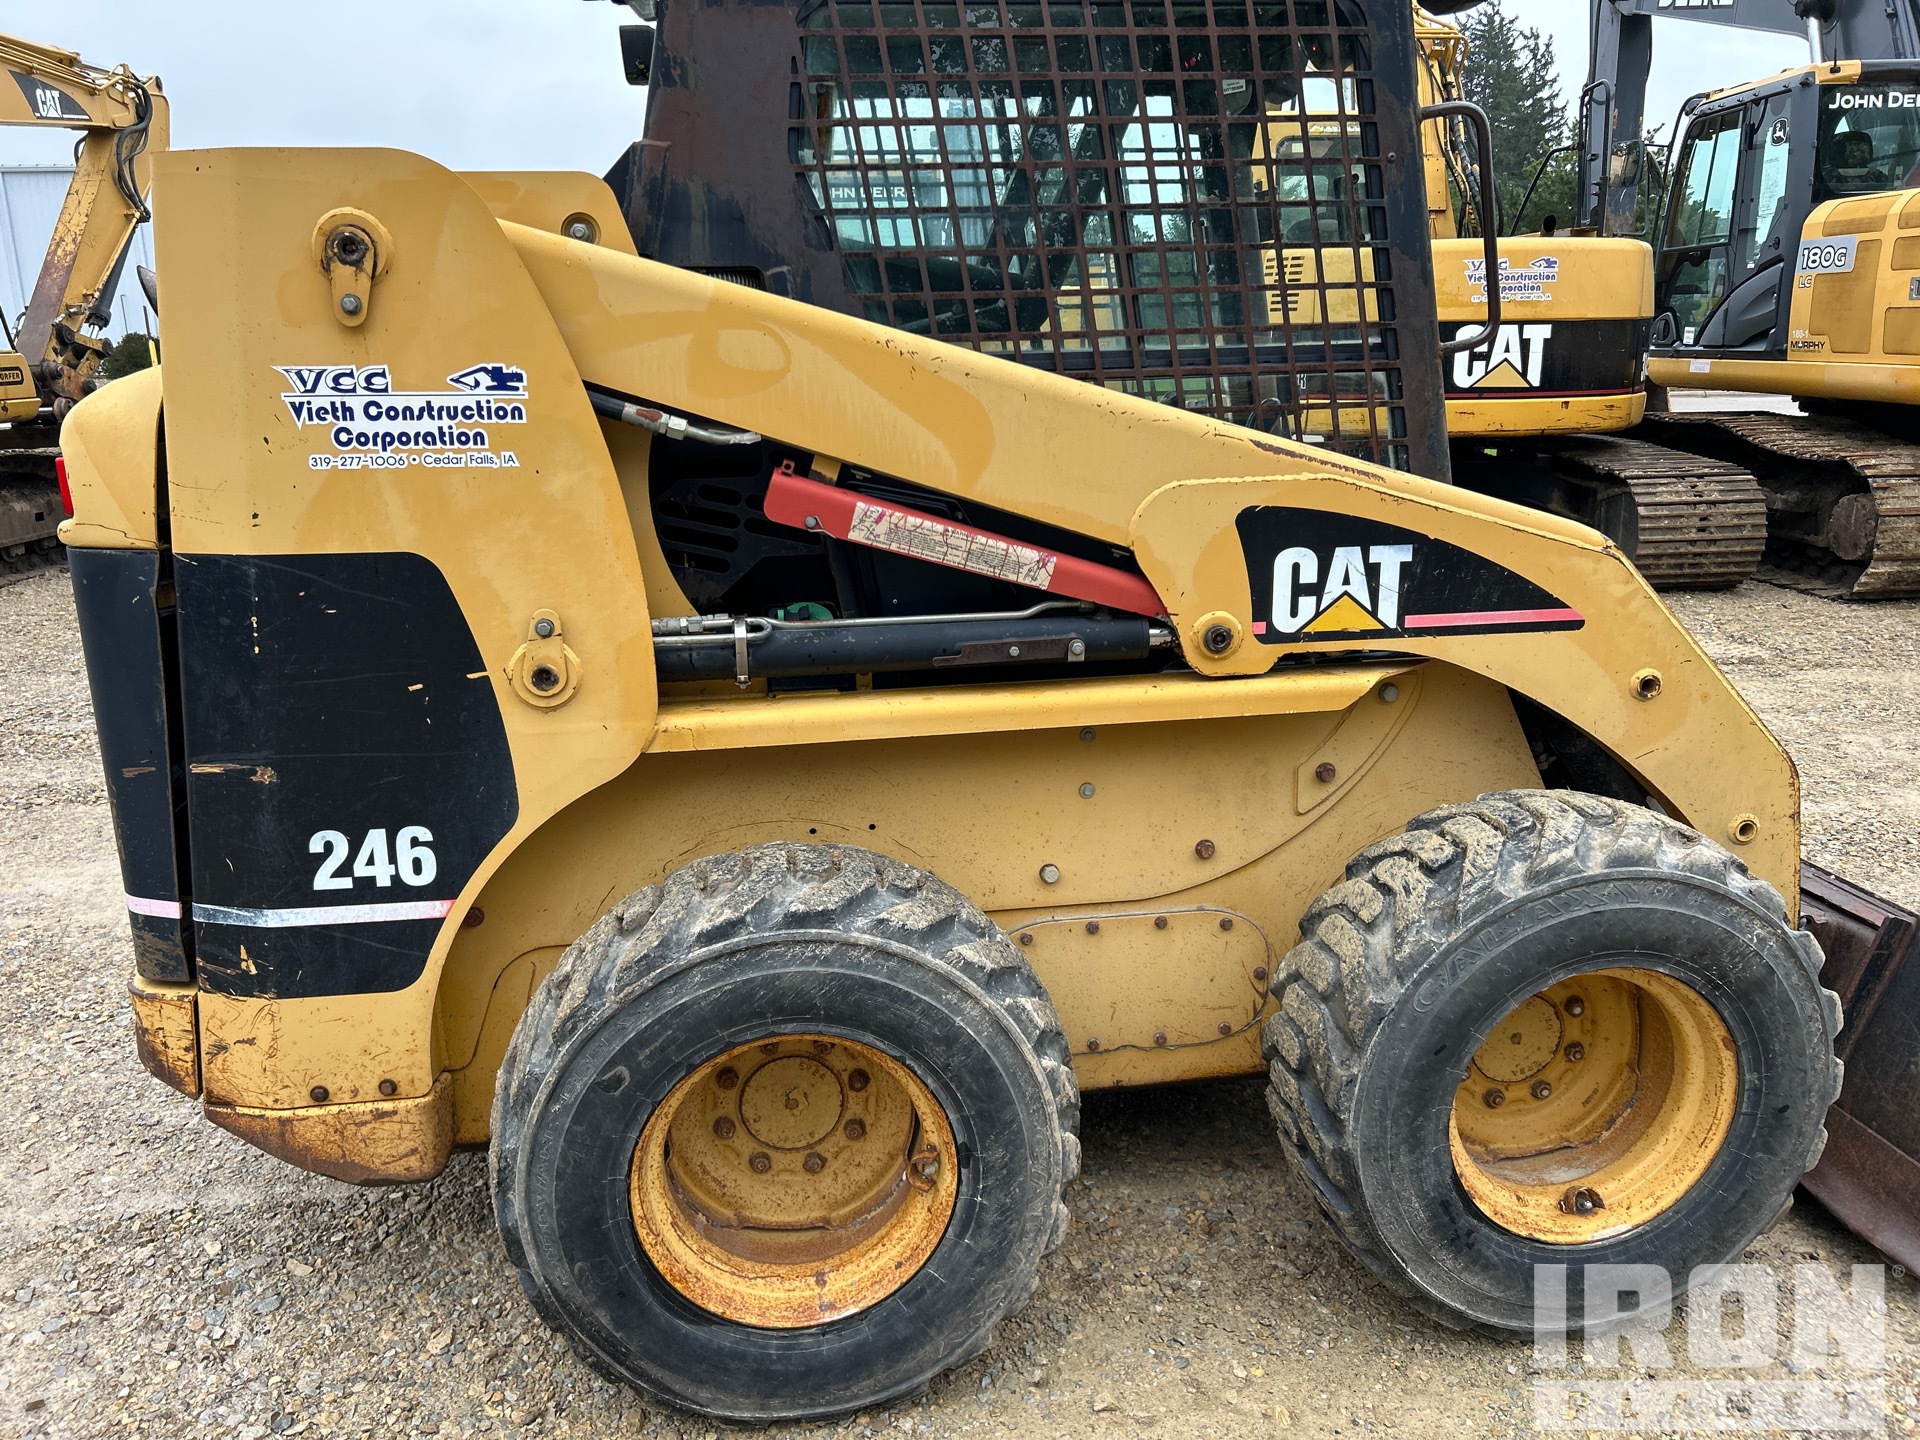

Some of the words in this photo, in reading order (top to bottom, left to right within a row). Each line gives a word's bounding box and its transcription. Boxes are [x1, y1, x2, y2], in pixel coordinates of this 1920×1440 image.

[36, 88, 63, 118] CAT
[1828, 92, 1883, 109] JOHN
[1802, 244, 1848, 270] 180G
[1467, 272, 1487, 283] Viet
[1798, 275, 1812, 288] LC
[1453, 324, 1552, 388] CAT
[1790, 340, 1826, 350] MURPHY
[289, 400, 355, 422] Vieth
[363, 399, 524, 421] Construction
[333, 425, 486, 452] Corporation
[311, 455, 406, 468] 319-277-1006
[423, 454, 463, 466] Cedar
[470, 454, 498, 467] Falls,
[503, 453, 516, 465] IA
[1271, 544, 1413, 633] CAT
[309, 825, 437, 890] 246
[1413, 883, 1642, 1013] GALAXY
